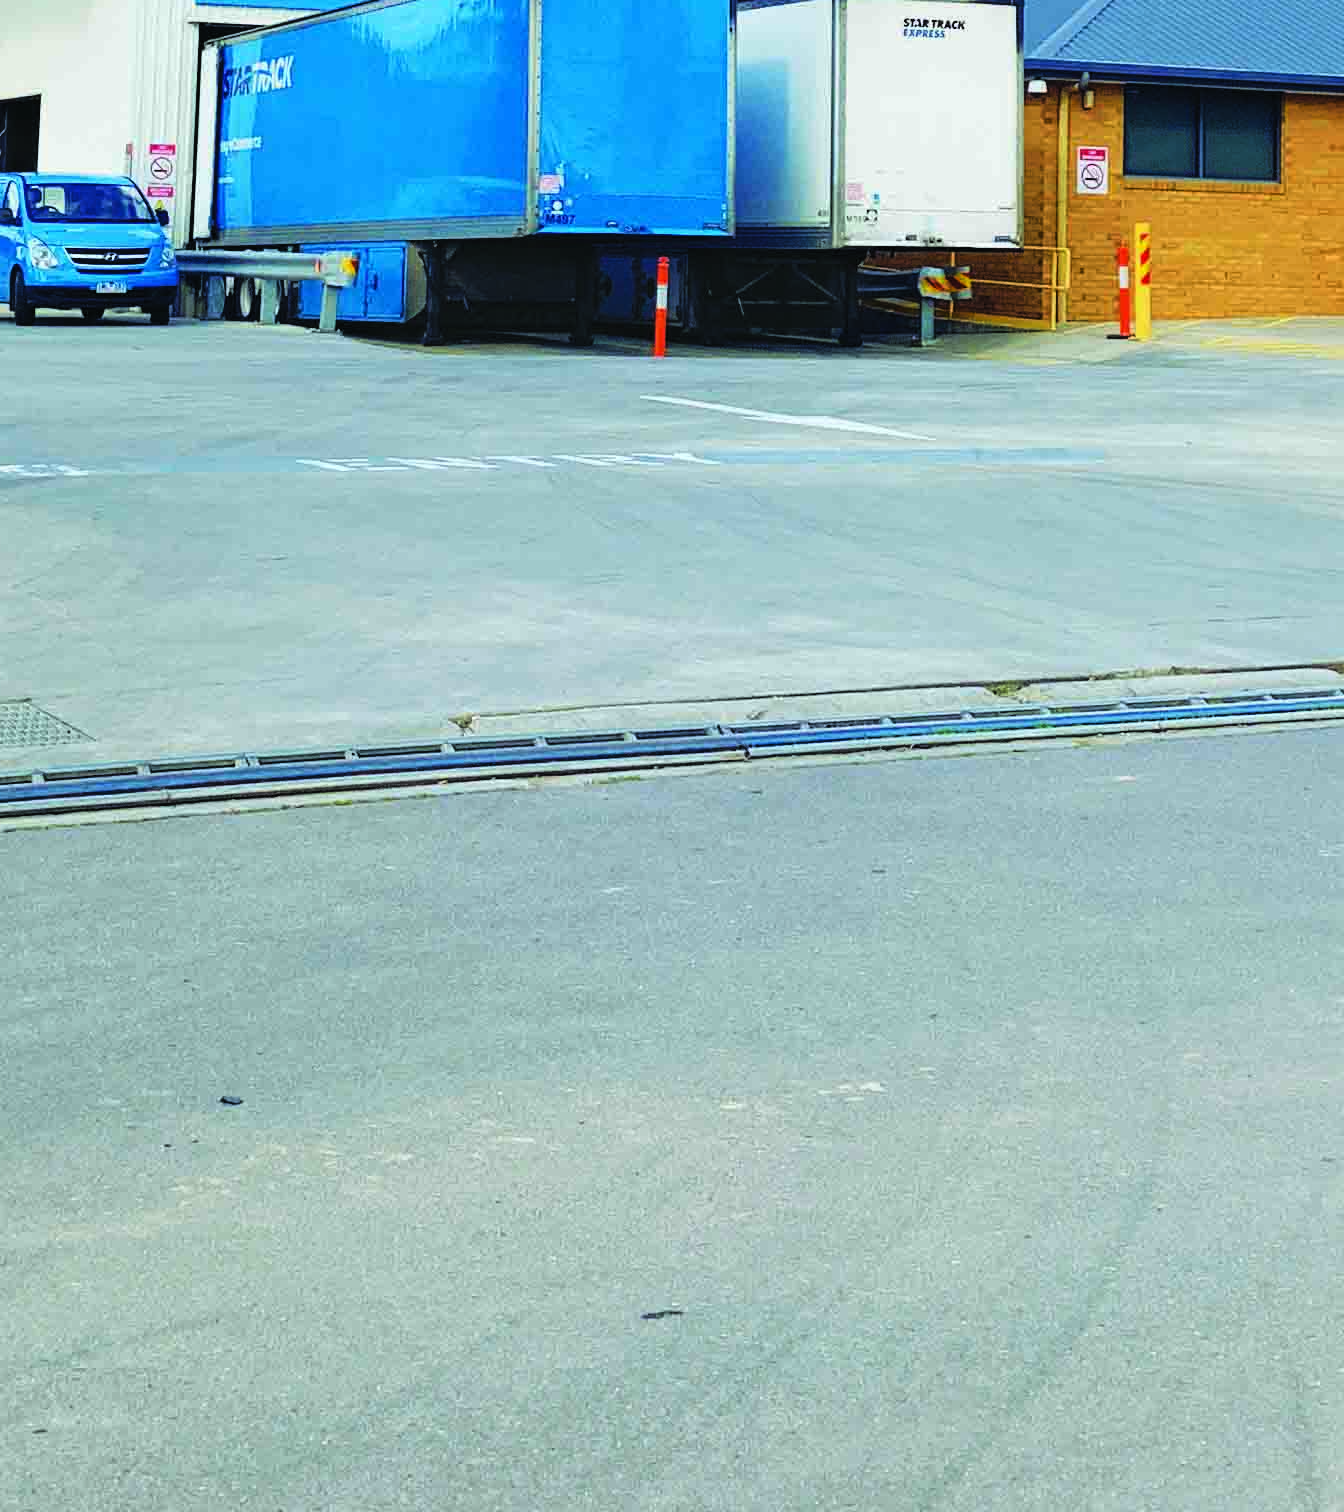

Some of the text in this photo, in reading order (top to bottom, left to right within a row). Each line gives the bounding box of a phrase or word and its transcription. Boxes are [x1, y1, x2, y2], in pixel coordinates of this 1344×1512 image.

[903, 18, 965, 30] STAR TRACK
[903, 28, 946, 38] EXPRESS
[223, 55, 295, 100] STARTRACK
